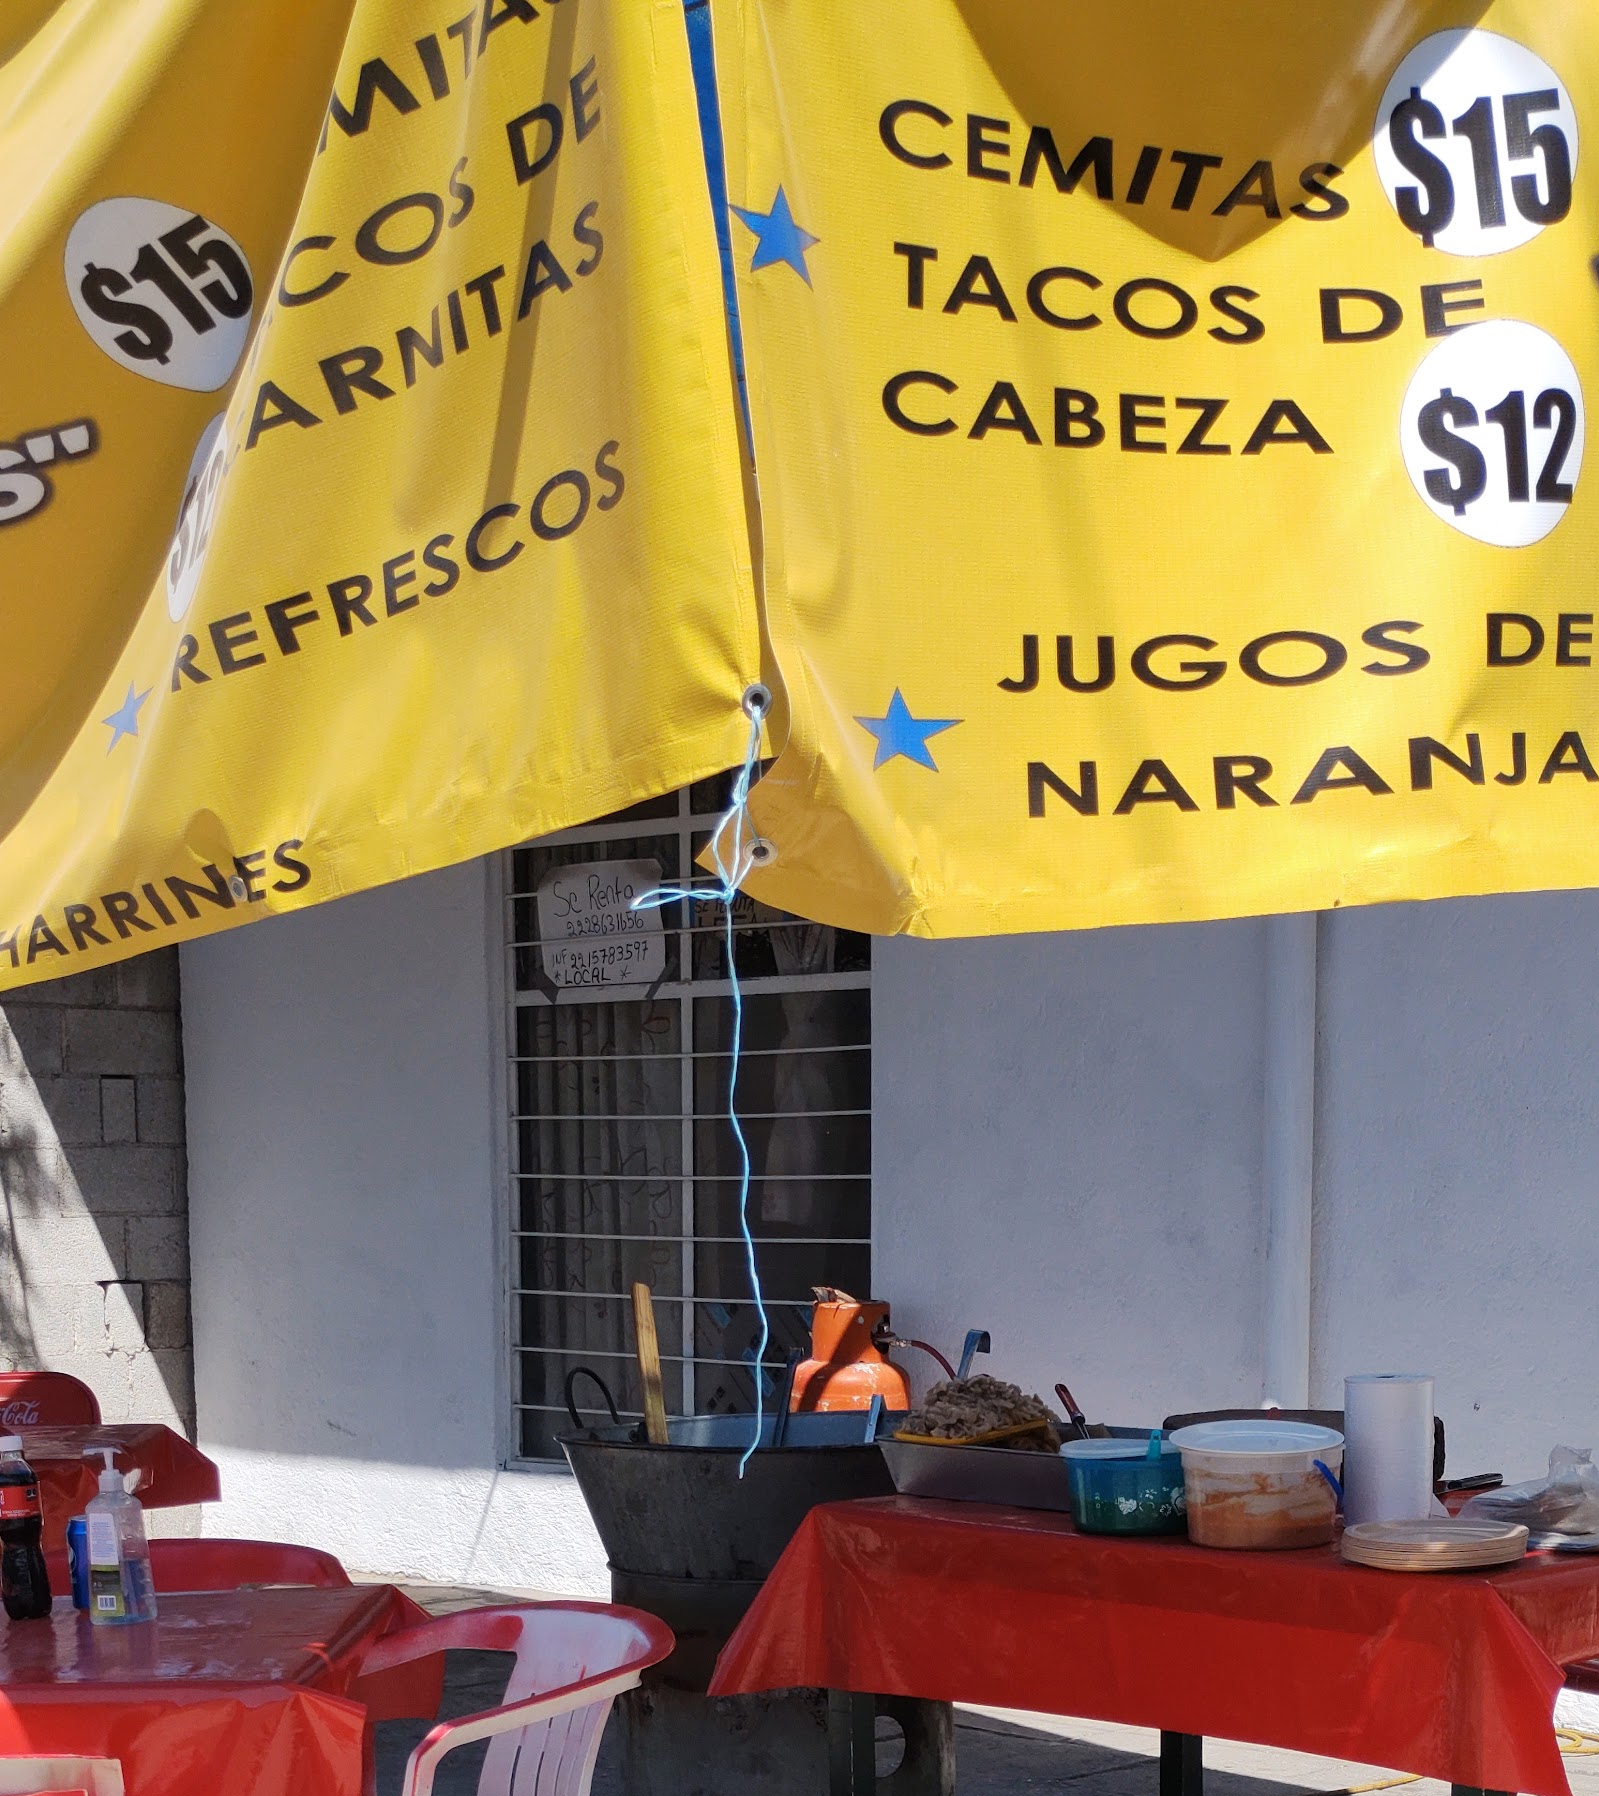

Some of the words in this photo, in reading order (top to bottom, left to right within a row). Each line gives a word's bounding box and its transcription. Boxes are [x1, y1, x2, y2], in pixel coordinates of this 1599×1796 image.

[318, 0, 562, 156] MITA
[505, 55, 601, 187] DE
[879, 98, 1350, 222] CEMITAS
[1388, 86, 1573, 248] $15
[80, 215, 254, 365] $15
[228, 201, 604, 475] ARNITAS
[892, 240, 1267, 346] TACOS
[1318, 278, 1486, 345] DE
[881, 369, 1335, 456] CABEZA
[1416, 386, 1578, 518] $12
[169, 440, 626, 692] REFRESCOS
[997, 620, 1431, 694] JUGOS
[1485, 612, 1594, 668] DE
